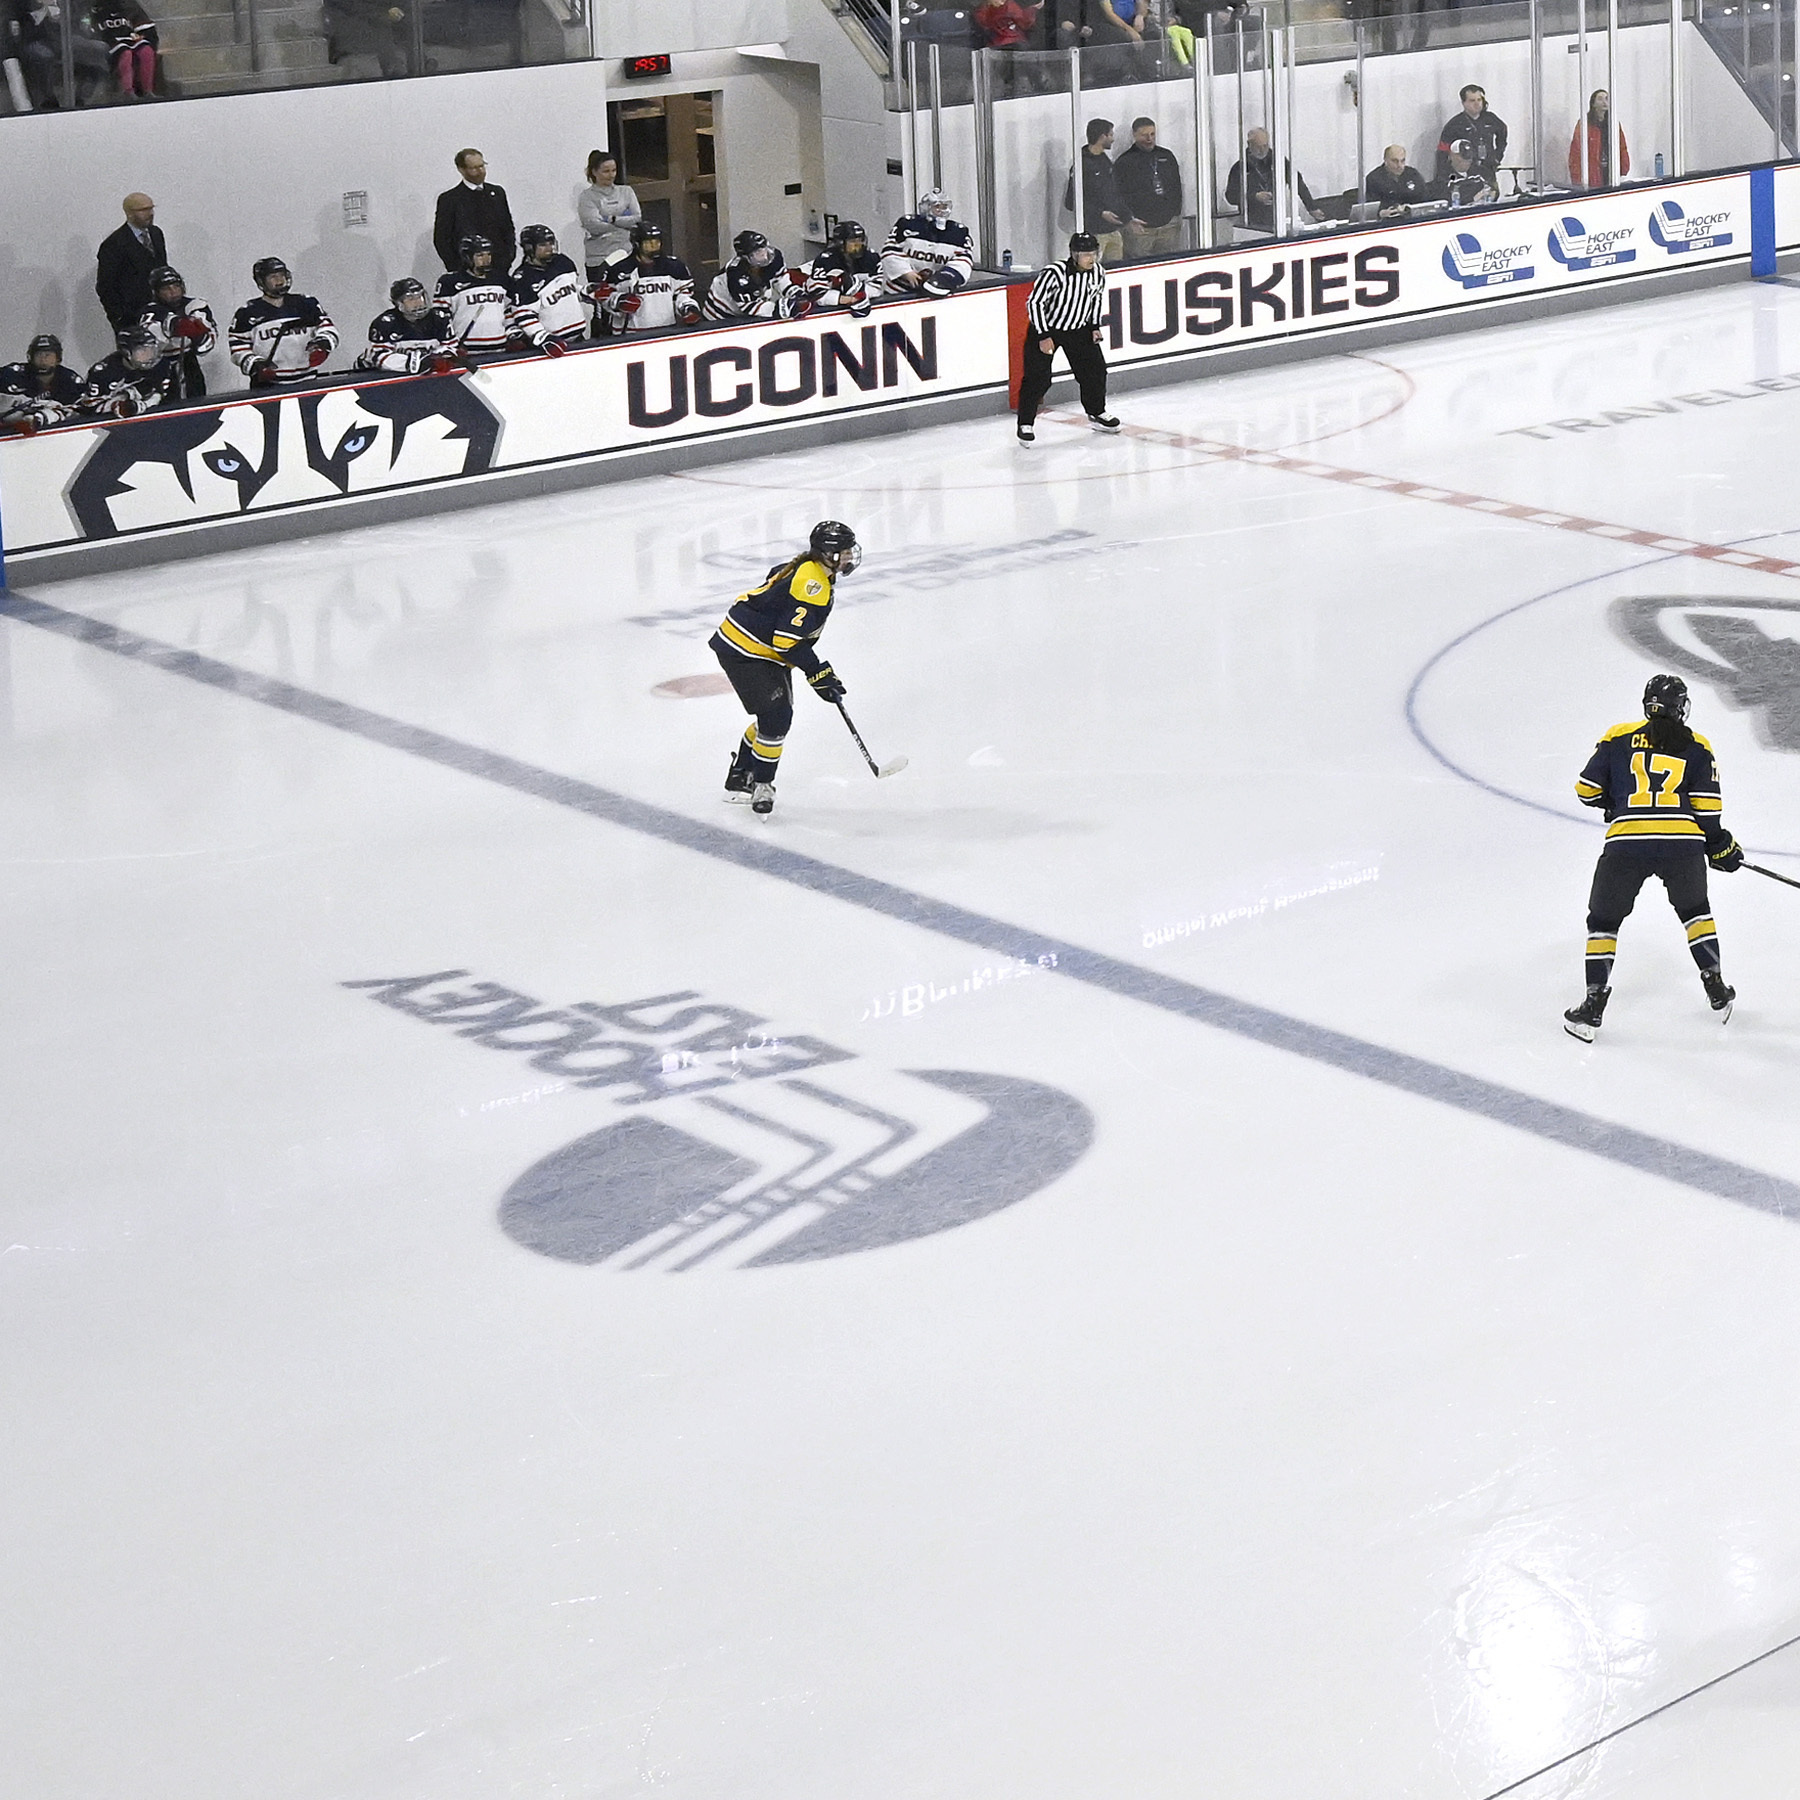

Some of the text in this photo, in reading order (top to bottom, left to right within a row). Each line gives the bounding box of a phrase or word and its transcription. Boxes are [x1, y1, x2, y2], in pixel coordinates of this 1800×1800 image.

[1684, 211, 1731, 229] HOCKEY
[1586, 227, 1635, 245] HOCKEY
[1684, 224, 1713, 239] EAST
[907, 248, 949, 264] UCONN
[1483, 244, 1533, 261] HOCKEY
[1585, 241, 1615, 255] EAST
[1482, 258, 1512, 272] EAST
[1101, 245, 1400, 350] HUSKIES
[627, 316, 938, 429] UCONN
[1627, 751, 1687, 809] 17
